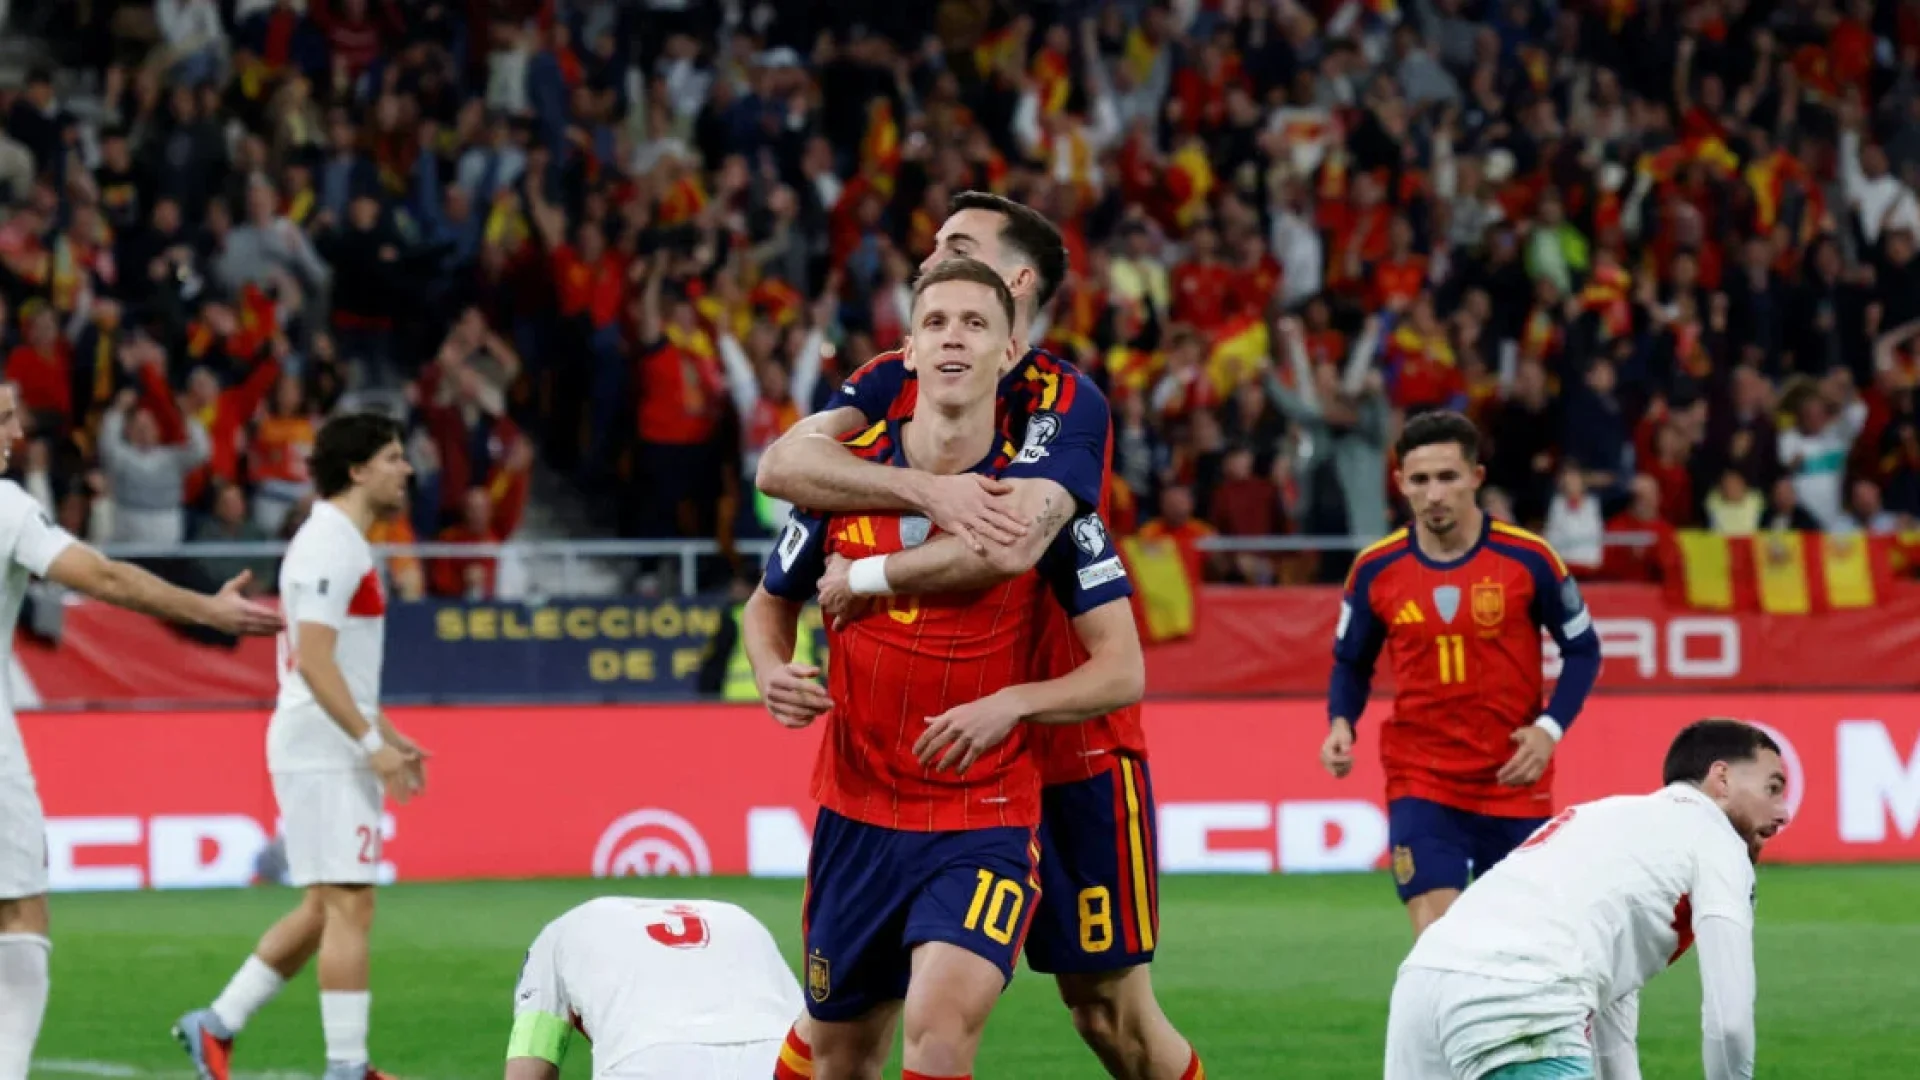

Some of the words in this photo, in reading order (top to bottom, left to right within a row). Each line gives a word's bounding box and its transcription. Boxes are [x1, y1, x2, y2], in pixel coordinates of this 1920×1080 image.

[435, 601, 721, 641] SELECCIÓN
[588, 648, 655, 681] DE
[1436, 634, 1467, 684] 11
[963, 868, 1024, 946] 10
[1077, 885, 1113, 953] 8
